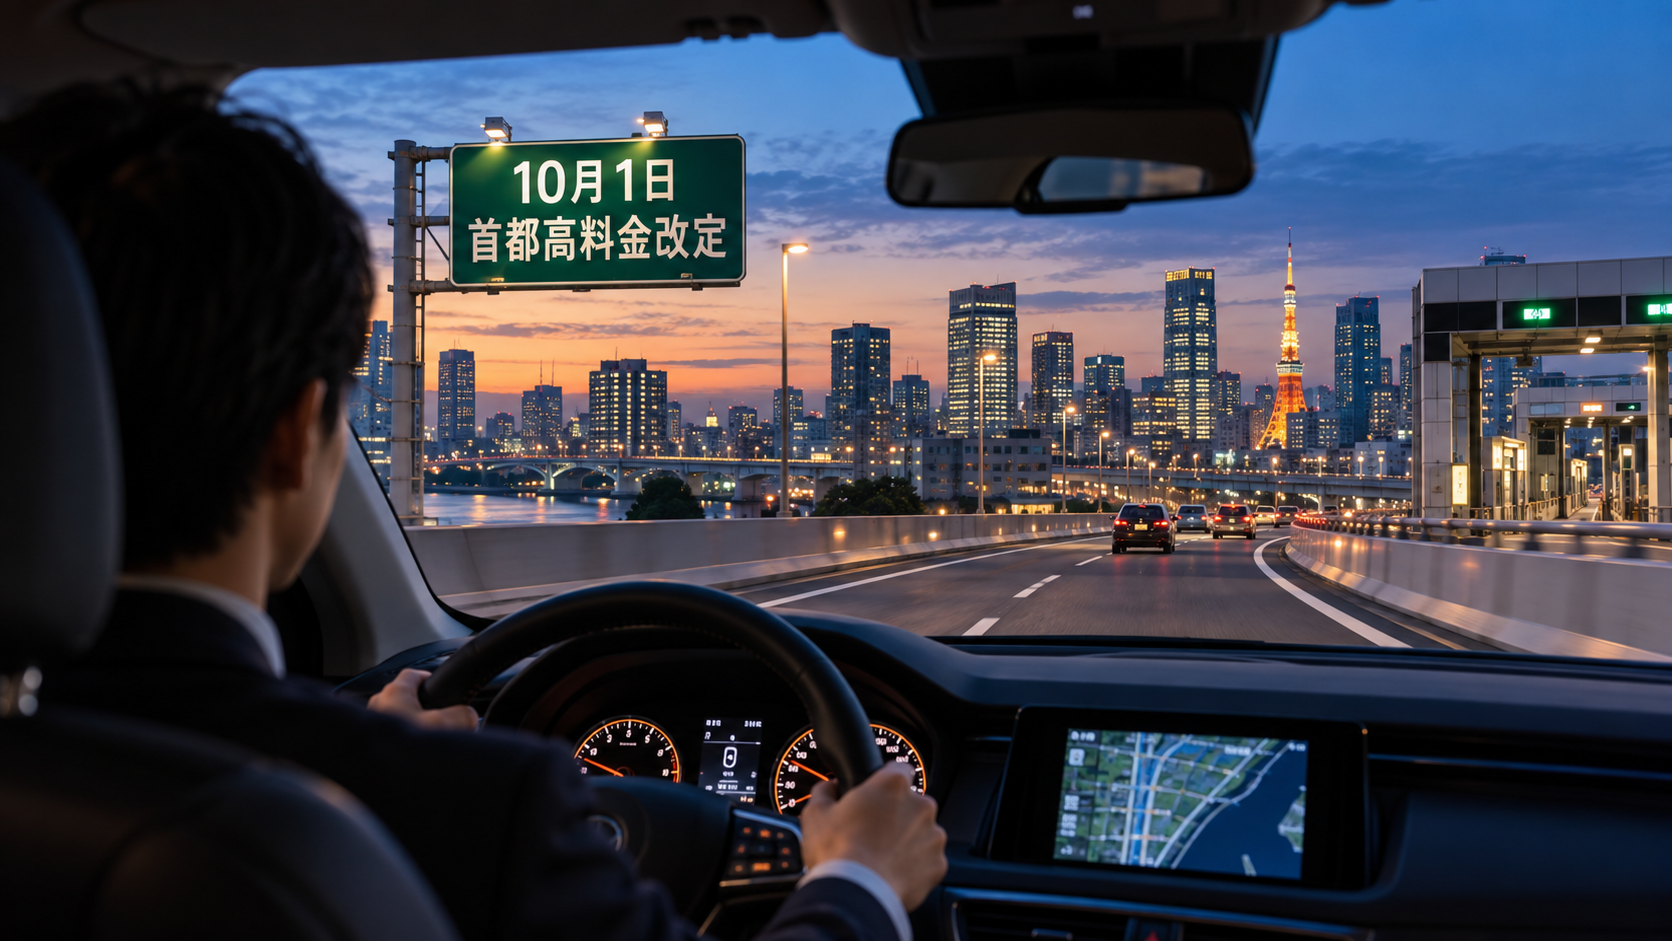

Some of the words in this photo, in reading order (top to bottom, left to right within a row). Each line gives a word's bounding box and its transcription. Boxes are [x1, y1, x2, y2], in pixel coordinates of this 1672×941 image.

[513, 158, 674, 205] 10月1日
[467, 212, 727, 263] 首都高料金改定
